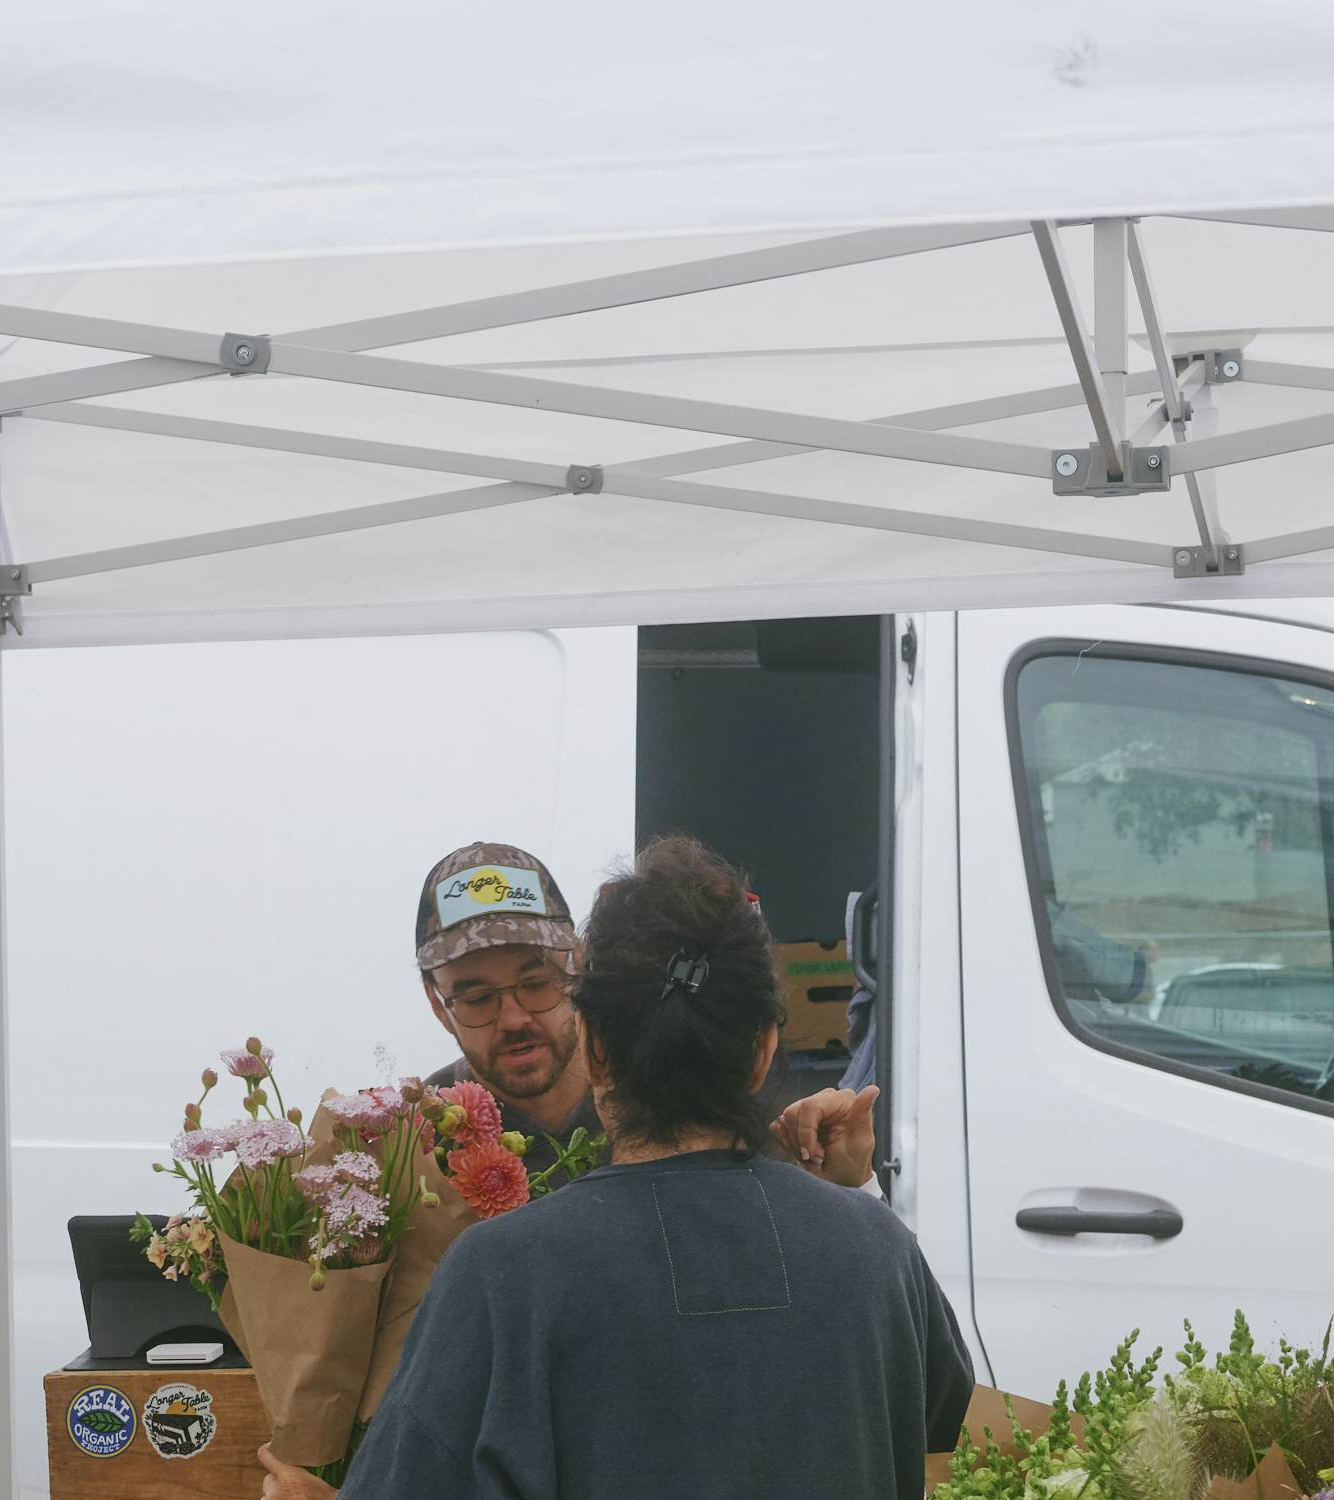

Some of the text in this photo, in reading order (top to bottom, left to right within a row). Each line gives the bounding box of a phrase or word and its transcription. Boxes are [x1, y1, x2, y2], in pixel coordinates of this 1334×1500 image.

[444, 875, 501, 899] Longer
[495, 885, 537, 901] Table
[73, 1389, 130, 1423] REAL
[147, 1391, 210, 1412] Longer Table
[74, 1423, 127, 1445] ORGANIC
[81, 1440, 120, 1453] PROJECT
